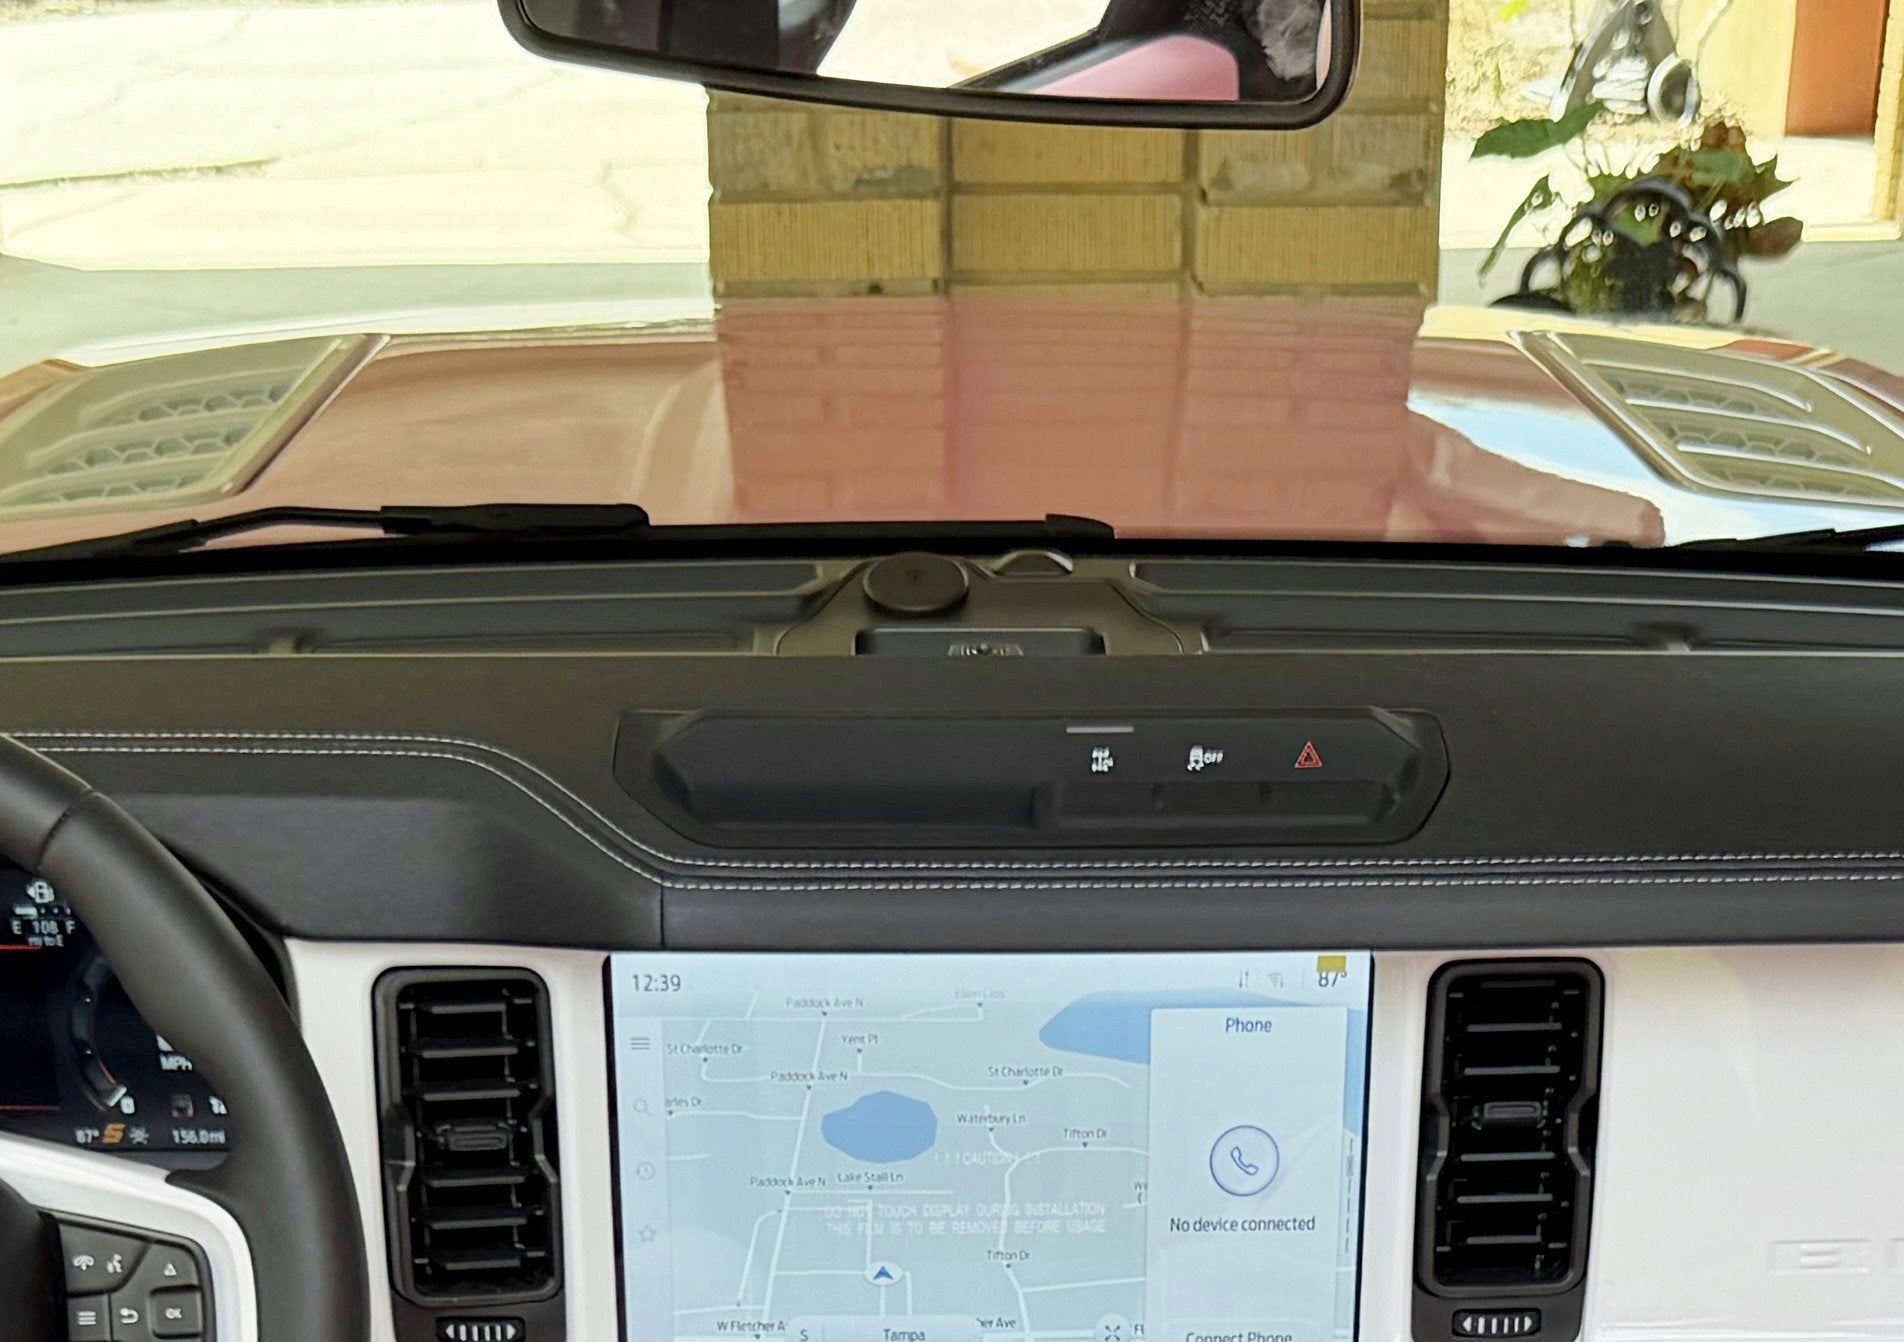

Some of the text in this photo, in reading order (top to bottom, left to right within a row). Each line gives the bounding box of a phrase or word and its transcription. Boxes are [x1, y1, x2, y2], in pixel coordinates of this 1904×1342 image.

[632, 974, 682, 993] 12:39
[786, 997, 831, 1008] Paddock
[834, 997, 853, 1008] Ave
[1225, 1017, 1273, 1033] Phone
[680, 1043, 730, 1055] Charlotte
[770, 1071, 814, 1082] Paddock
[817, 1071, 837, 1082] Ave
[988, 1066, 1064, 1078] St Charlotte Dr
[957, 1113, 1026, 1125] Waterbury Ln
[1064, 1128, 1107, 1139] Tifton Dr
[750, 1176, 794, 1188] Paddock
[796, 1176, 815, 1187] Ave
[837, 1172, 862, 1183] Lake
[1169, 1215, 1316, 1233] No device connected
[716, 1320, 728, 1331] W
[730, 1320, 775, 1332] Fletcher
[800, 1329, 810, 1342] S
[883, 1328, 927, 1342] Tampa
